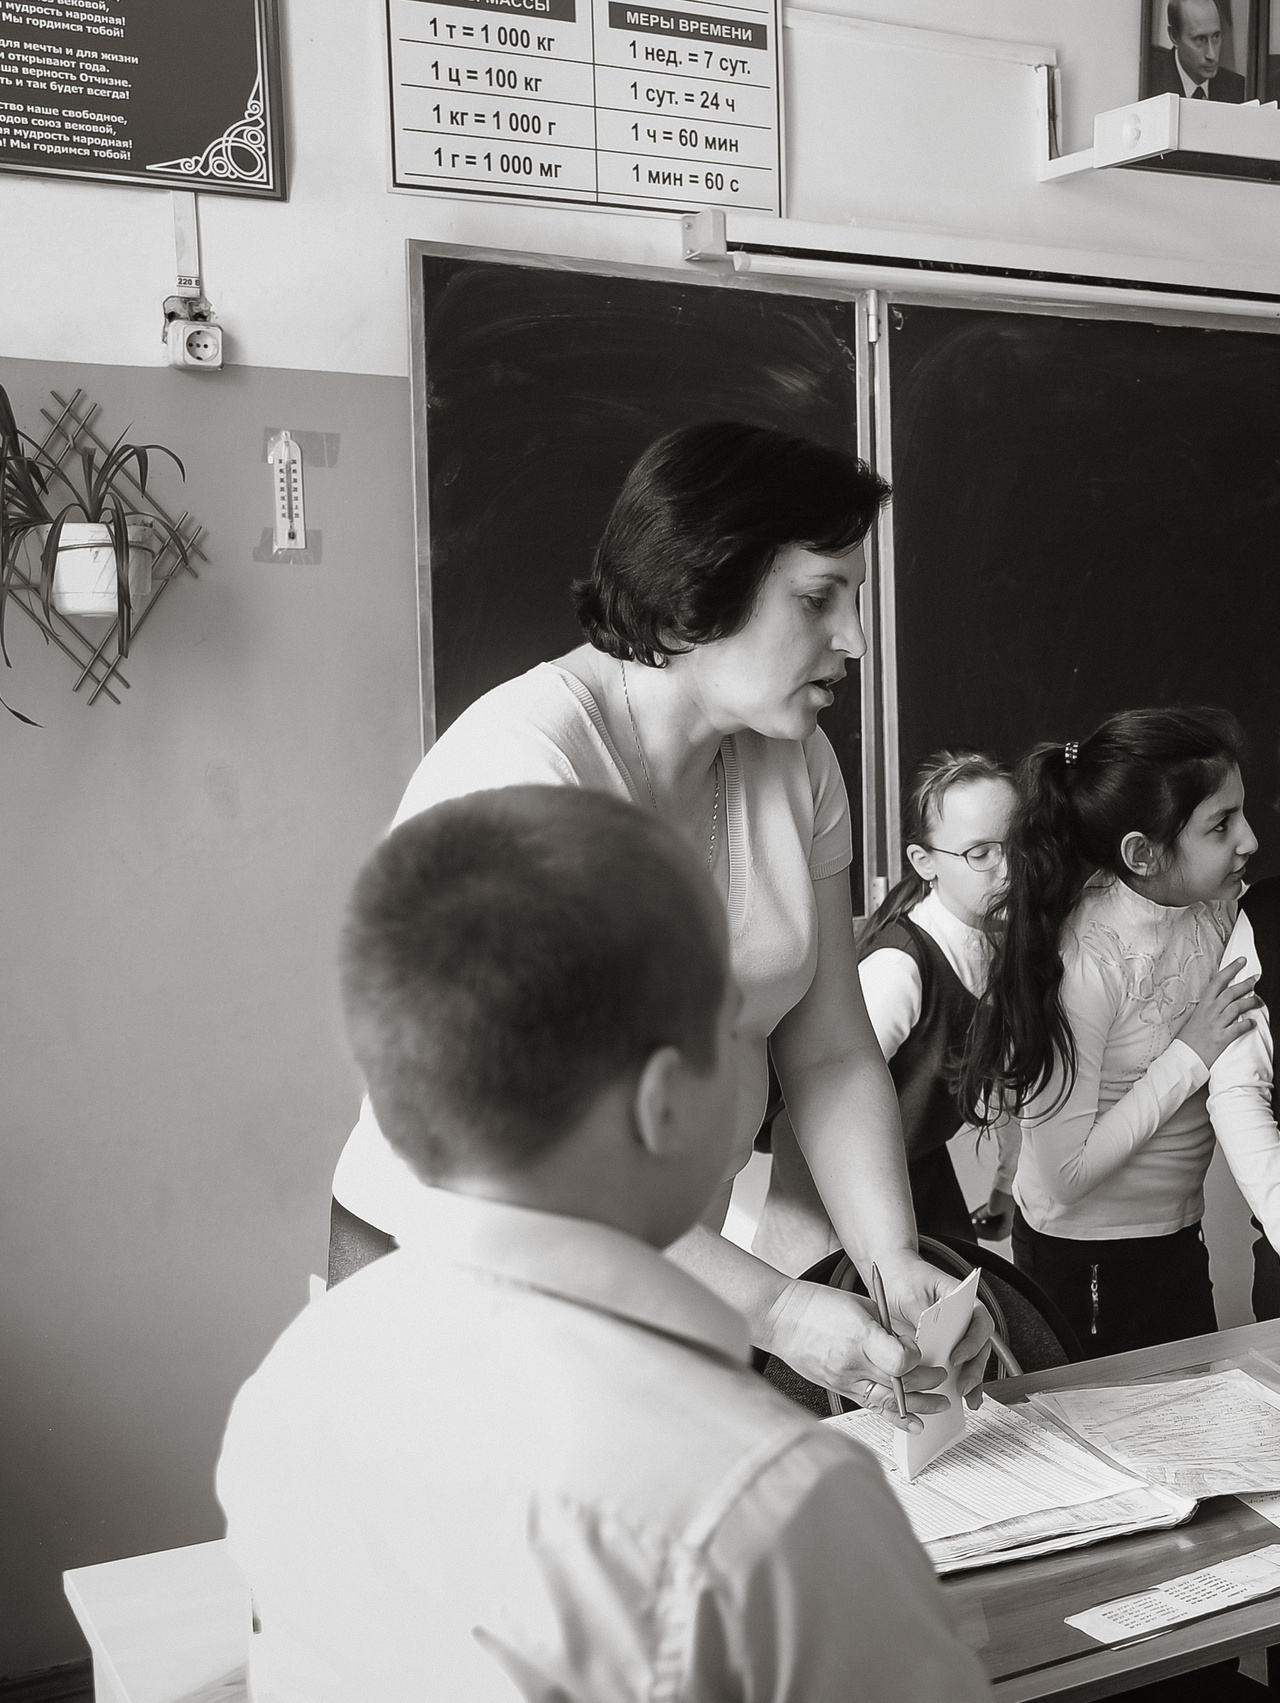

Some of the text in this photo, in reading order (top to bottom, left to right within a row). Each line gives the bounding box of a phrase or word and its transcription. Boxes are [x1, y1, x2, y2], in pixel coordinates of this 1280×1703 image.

[1, 11, 125, 38] Мы гордимся тобой!
[5, 1, 63, 16] мудрость
[65, 10, 126, 26] народная!
[626, 11, 752, 42] МЕРЫ ВРЕМЕНИ
[430, 17, 438, 37] 1
[446, 24, 457, 39] т
[481, 24, 489, 44] 1
[498, 26, 530, 48] 000
[537, 36, 555, 51] кг
[0, 38, 139, 65] для мечты и для жизни
[8, 52, 77, 68] открывают
[79, 61, 110, 73] года.
[629, 40, 637, 58] 1
[645, 47, 683, 67] нед.
[704, 51, 713, 69] 7
[720, 57, 751, 77] сут.
[0, 64, 132, 88] ша верность Отчизне.
[0, 76, 130, 100] ть и так будет всегда!
[432, 61, 440, 80] 1
[449, 68, 461, 86] ц
[485, 67, 518, 89] 100
[524, 77, 542, 93] кг
[631, 82, 638, 100] 1
[646, 87, 679, 107] сут.
[700, 91, 720, 110] 24
[726, 98, 735, 112] ч
[0, 114, 117, 137] одов союз вековой,
[26, 104, 60, 116] наше
[61, 109, 128, 126] свободное,
[433, 104, 441, 124] 1
[450, 111, 469, 126] кг
[493, 111, 501, 130] 1
[509, 113, 541, 134] 000
[549, 122, 556, 136] г
[9, 137, 31, 150] Мы
[33, 142, 90, 157] гордимся
[92, 149, 131, 161] тобой!
[13, 127, 71, 142] мудрость
[72, 134, 133, 149] народная!
[631, 123, 639, 141] 1
[647, 129, 657, 143] ч
[679, 129, 698, 148] 60
[705, 136, 739, 153] мин
[434, 147, 442, 167] 1
[451, 154, 460, 168] г
[484, 152, 491, 172] 1
[500, 154, 533, 175] 000
[540, 163, 562, 178] мг
[633, 164, 640, 182] 1
[648, 170, 683, 187] мин
[705, 172, 724, 191] 60
[730, 179, 739, 193] с
[178, 278, 193, 286] 220
